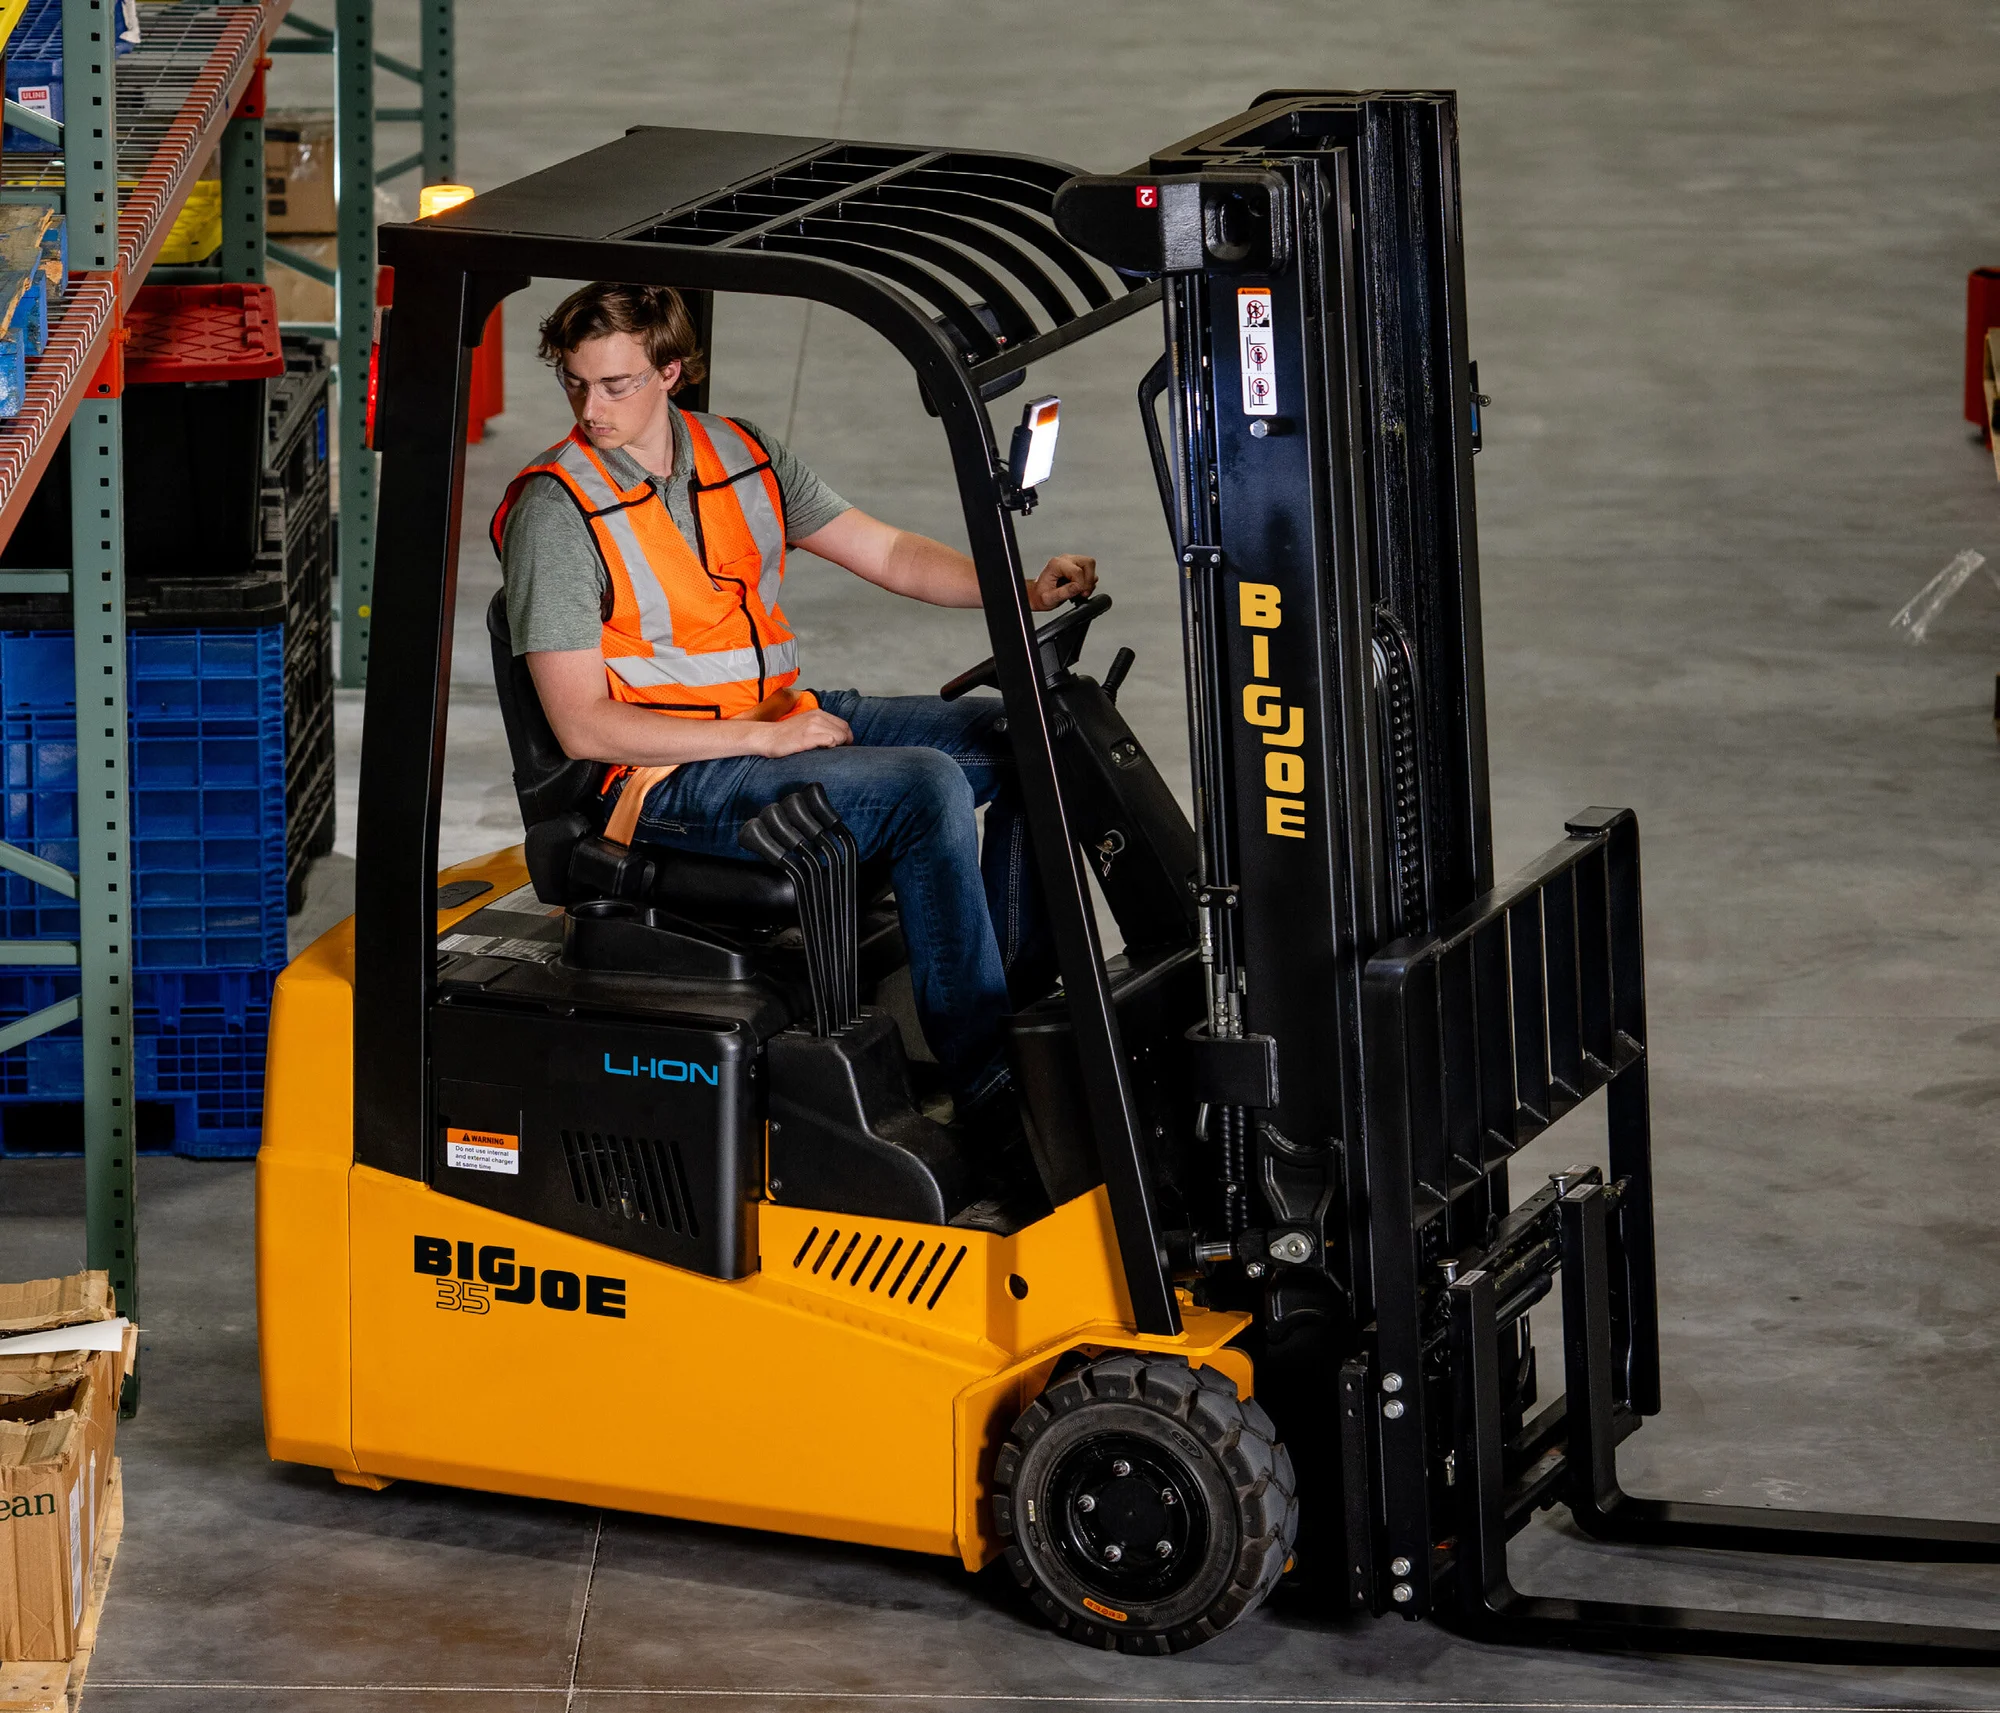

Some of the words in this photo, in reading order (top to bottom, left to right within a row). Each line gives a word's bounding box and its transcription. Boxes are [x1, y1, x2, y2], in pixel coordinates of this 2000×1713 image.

[22, 91, 46, 100] ULINE
[604, 1053, 718, 1086] LI-ION
[471, 1135, 504, 1145] WARNING
[467, 1154, 490, 1162] external
[491, 1156, 514, 1166] charger
[436, 1277, 490, 1315] 35
